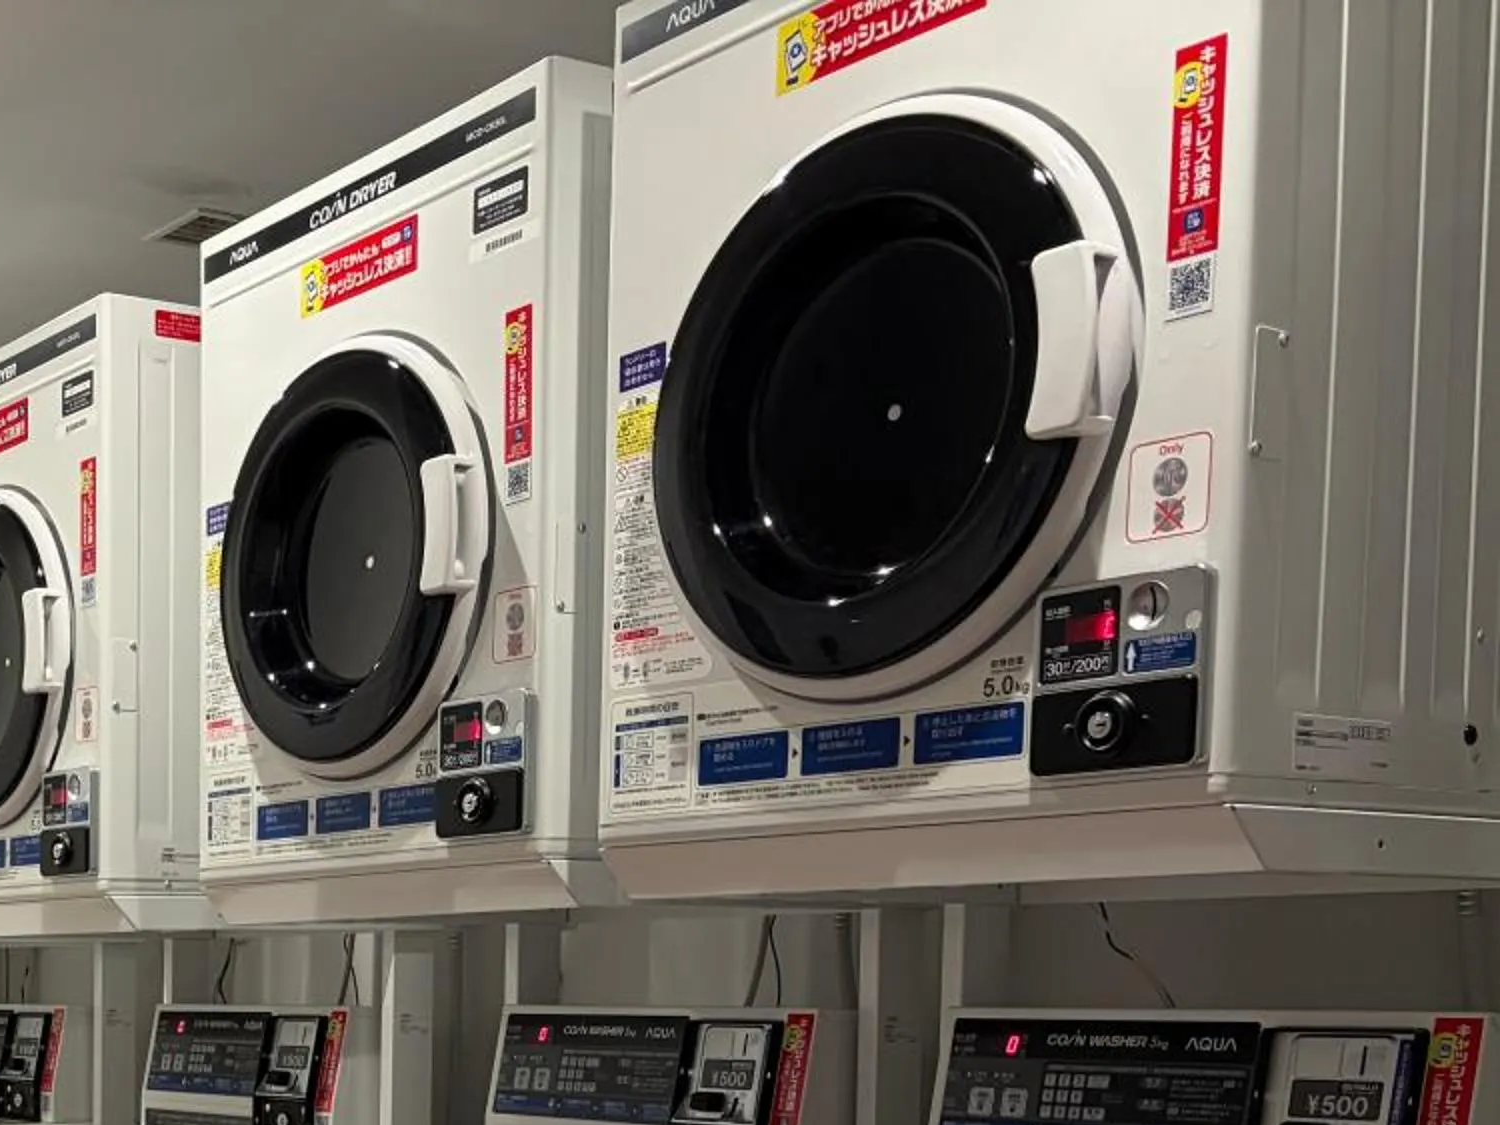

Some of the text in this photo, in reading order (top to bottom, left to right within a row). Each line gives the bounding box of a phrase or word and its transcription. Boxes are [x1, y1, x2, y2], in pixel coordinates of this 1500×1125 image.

[811, 0, 970, 66] キャッシュレス決
[812, 0, 902, 38] アプリでかん
[350, 171, 397, 208] DRYER
[1005, 1035, 1021, 1054] 0
[1089, 1034, 1149, 1048] WASHER
[1185, 1036, 1237, 1052] AQUA
[1307, 1094, 1369, 1117] ¥500
